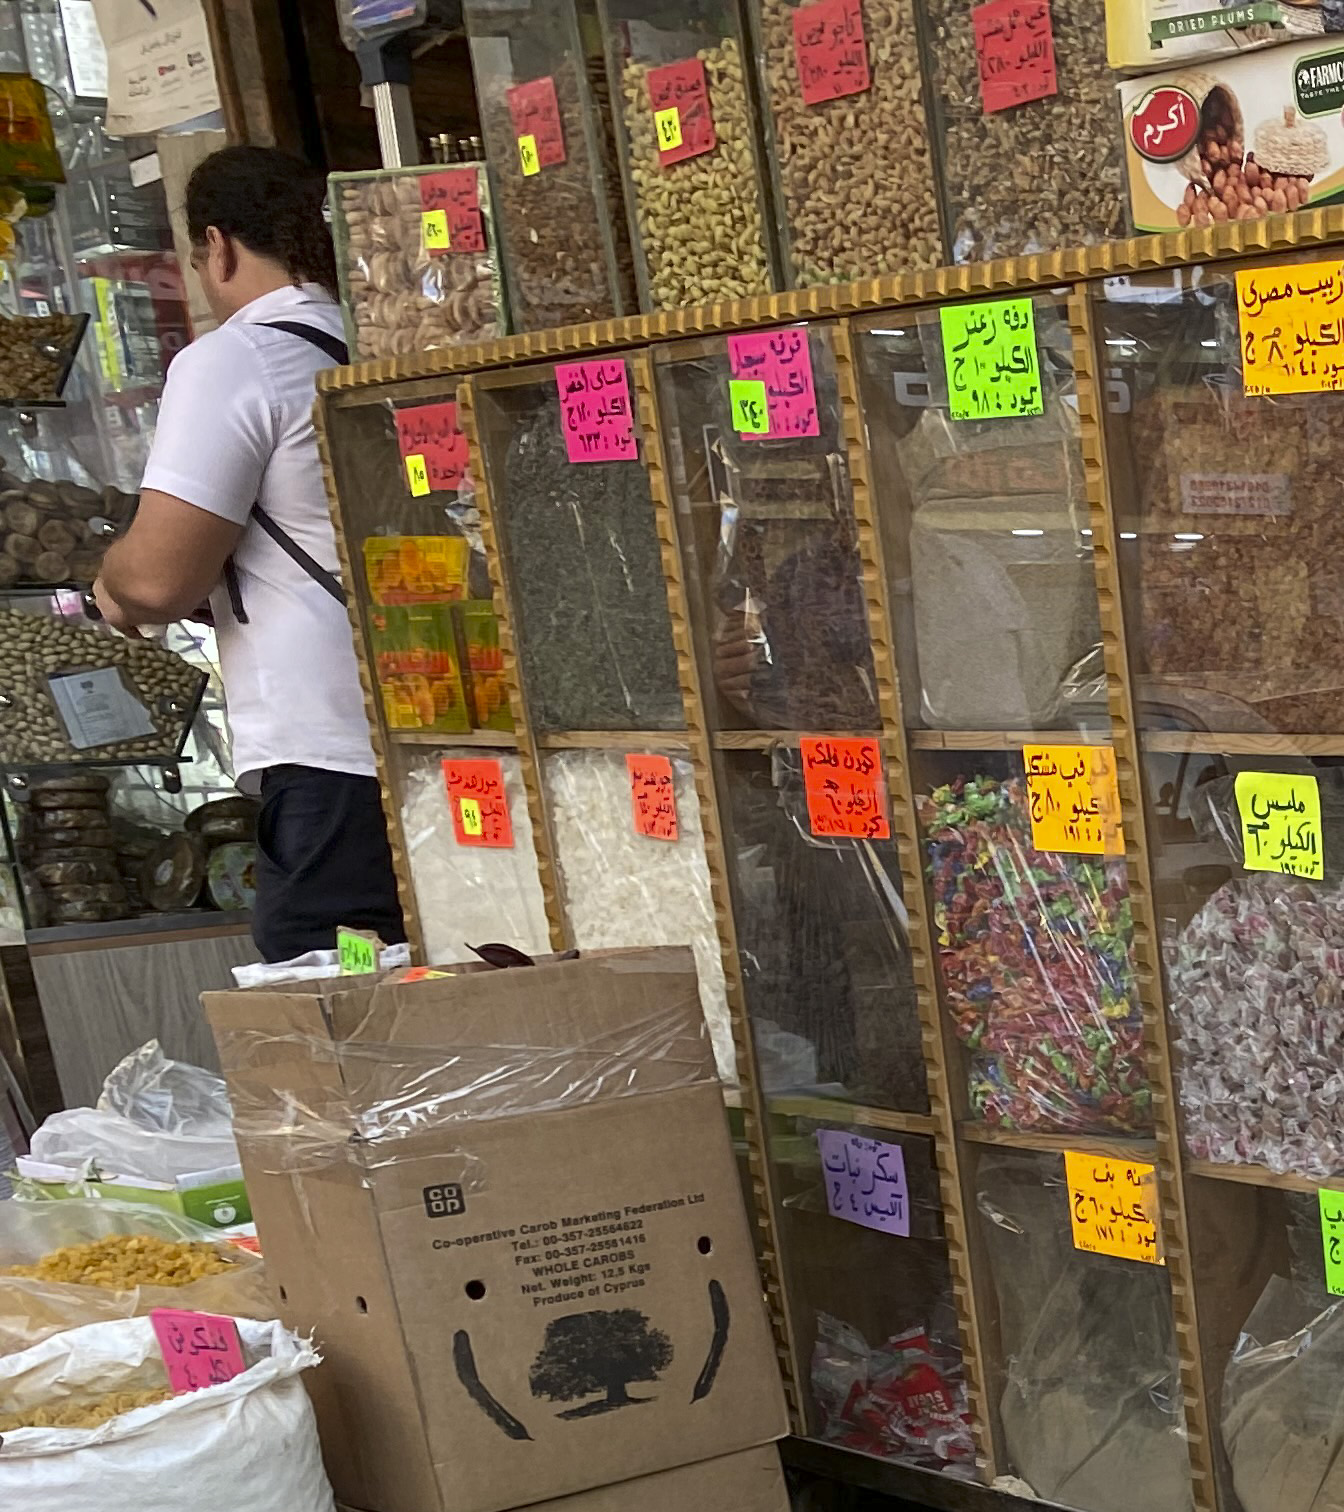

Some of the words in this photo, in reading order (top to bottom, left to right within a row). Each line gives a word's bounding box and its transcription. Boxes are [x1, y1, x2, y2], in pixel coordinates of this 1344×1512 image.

[1168, 16, 1207, 34] DRIED
[1210, 8, 1256, 28] PLUMS
[1143, 95, 1187, 150] أكرم
[1295, 270, 1344, 304] زبيب
[1251, 788, 1306, 822] ملبس
[1271, 821, 1318, 860] الكيلو
[860, 1152, 898, 1196] سكر
[432, 1229, 516, 1251] Co-operative
[519, 1220, 558, 1236] Carob
[561, 1208, 622, 1229] Marketing
[623, 1196, 685, 1216] Federation
[532, 1260, 580, 1278] WHOLE
[583, 1250, 636, 1269] CAROBS
[550, 1272, 598, 1291] Weight:
[628, 1262, 651, 1275] Kgs
[532, 1290, 586, 1307] Produce
[603, 1276, 646, 1296] Cyprus
